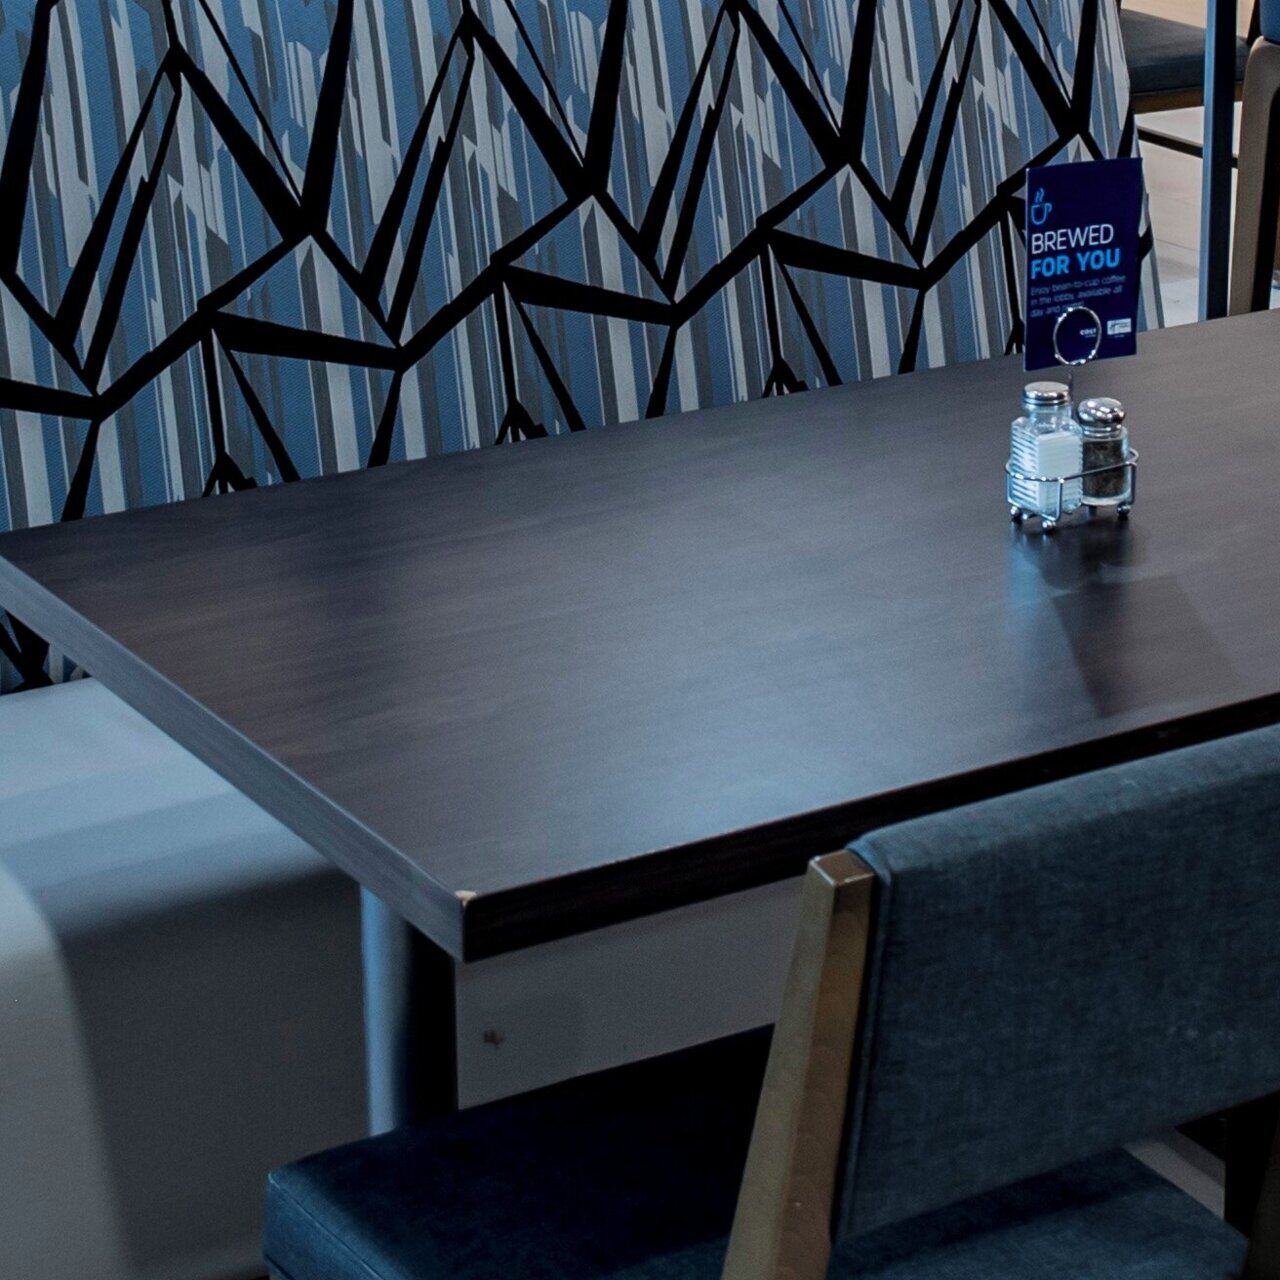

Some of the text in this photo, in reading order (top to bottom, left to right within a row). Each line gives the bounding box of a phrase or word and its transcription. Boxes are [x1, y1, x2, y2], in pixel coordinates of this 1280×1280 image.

[1031, 224, 1114, 254] BREWED
[1031, 248, 1121, 279] FOR YOU
